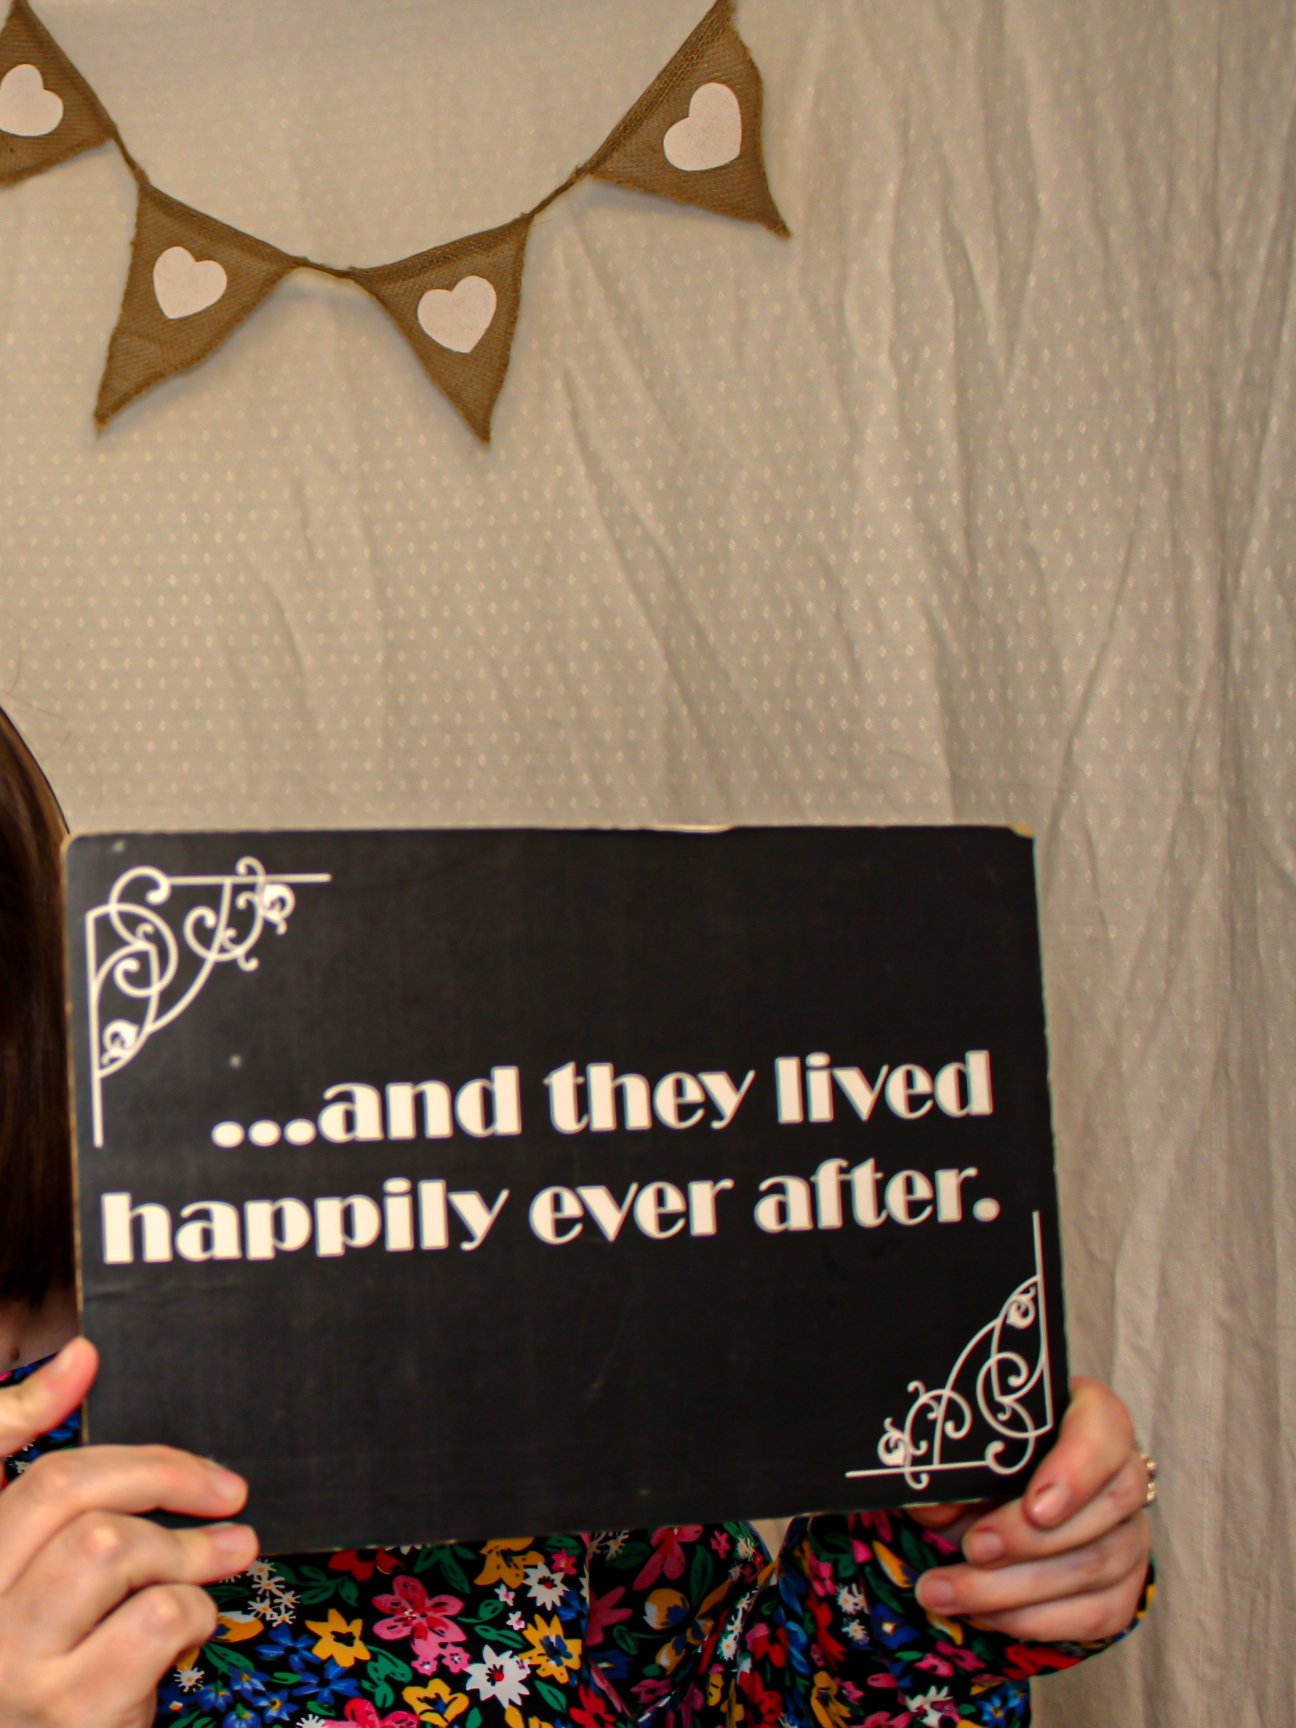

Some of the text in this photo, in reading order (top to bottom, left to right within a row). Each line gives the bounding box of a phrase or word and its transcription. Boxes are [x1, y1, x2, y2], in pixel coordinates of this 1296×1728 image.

[210, 1050, 993, 1148] ...and they lived
[101, 1158, 1000, 1265] happily ever after.
